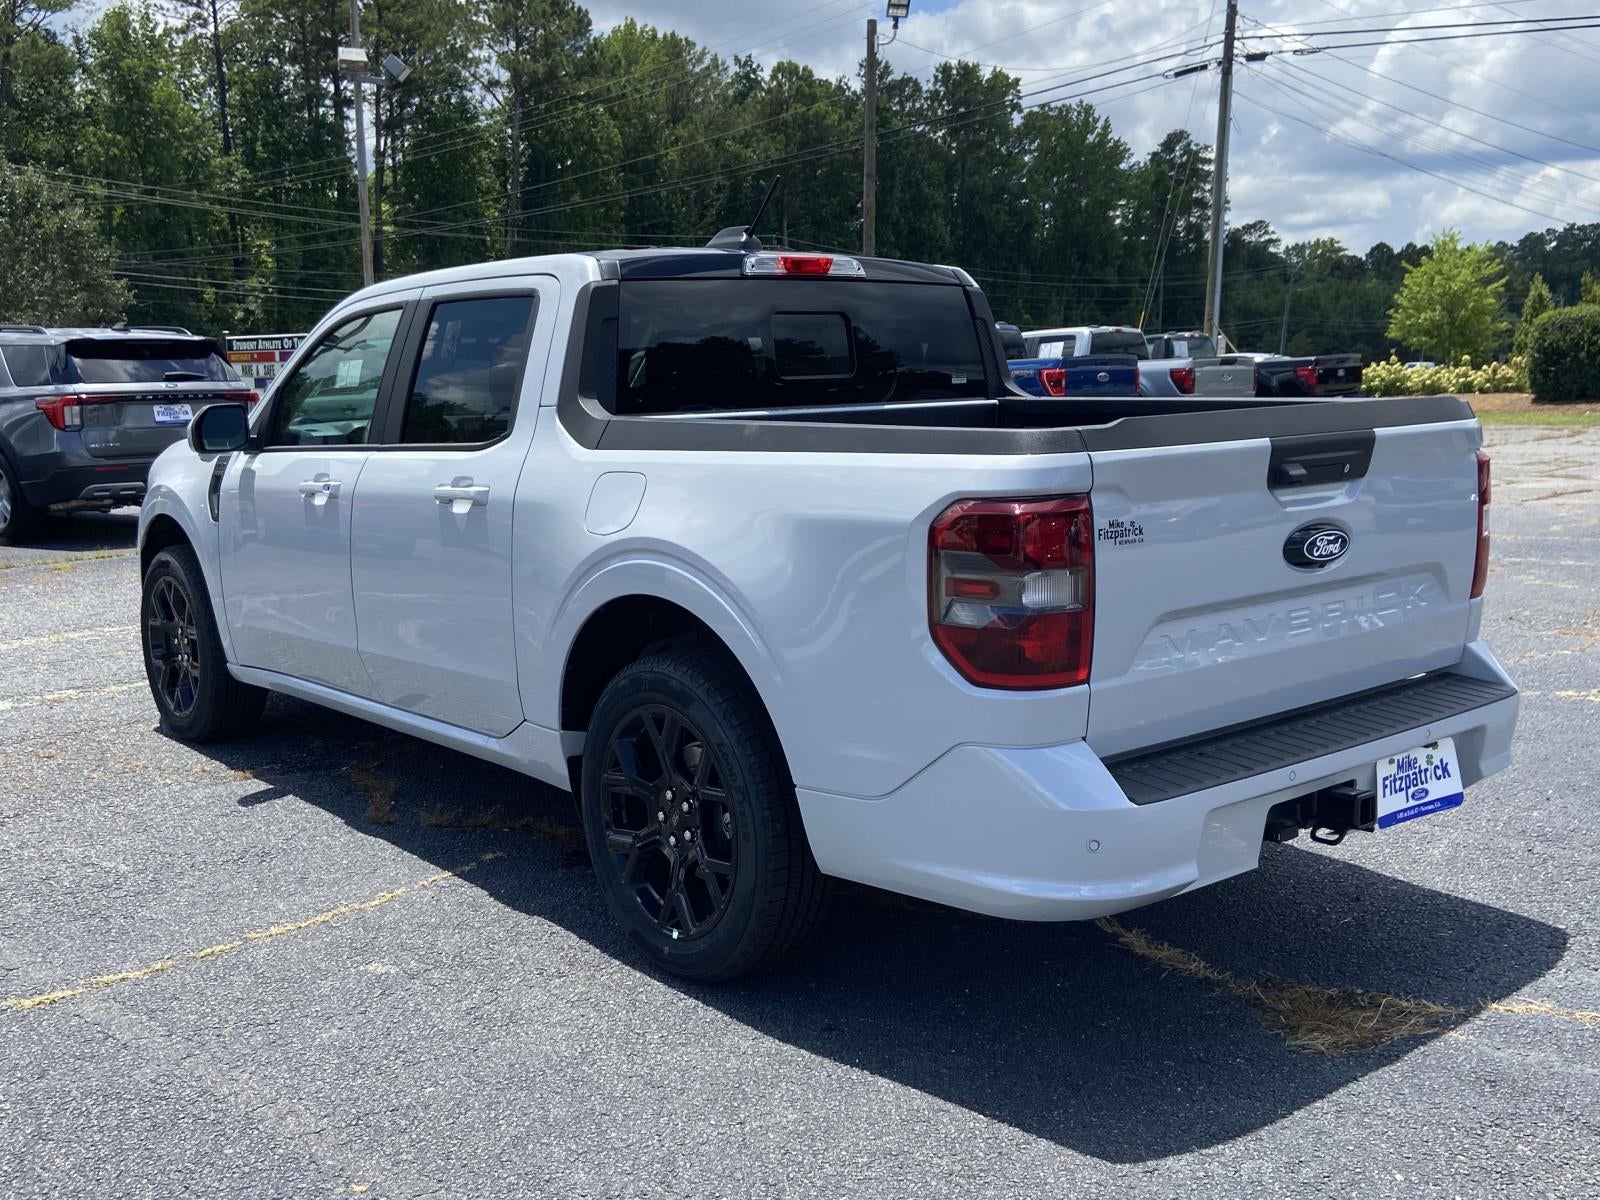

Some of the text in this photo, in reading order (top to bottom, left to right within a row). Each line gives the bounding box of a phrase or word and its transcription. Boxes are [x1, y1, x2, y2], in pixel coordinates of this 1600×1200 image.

[232, 340, 257, 350] STUDENT
[258, 339, 282, 349] ATHLETE
[1098, 524, 1144, 546] Fitzpatrick
[1108, 519, 1125, 529] Mike
[1311, 534, 1343, 558] Ford
[1157, 581, 1431, 662] MAVERICK
[1396, 754, 1418, 776] Mike
[1382, 757, 1452, 804] Fitzpatrick
